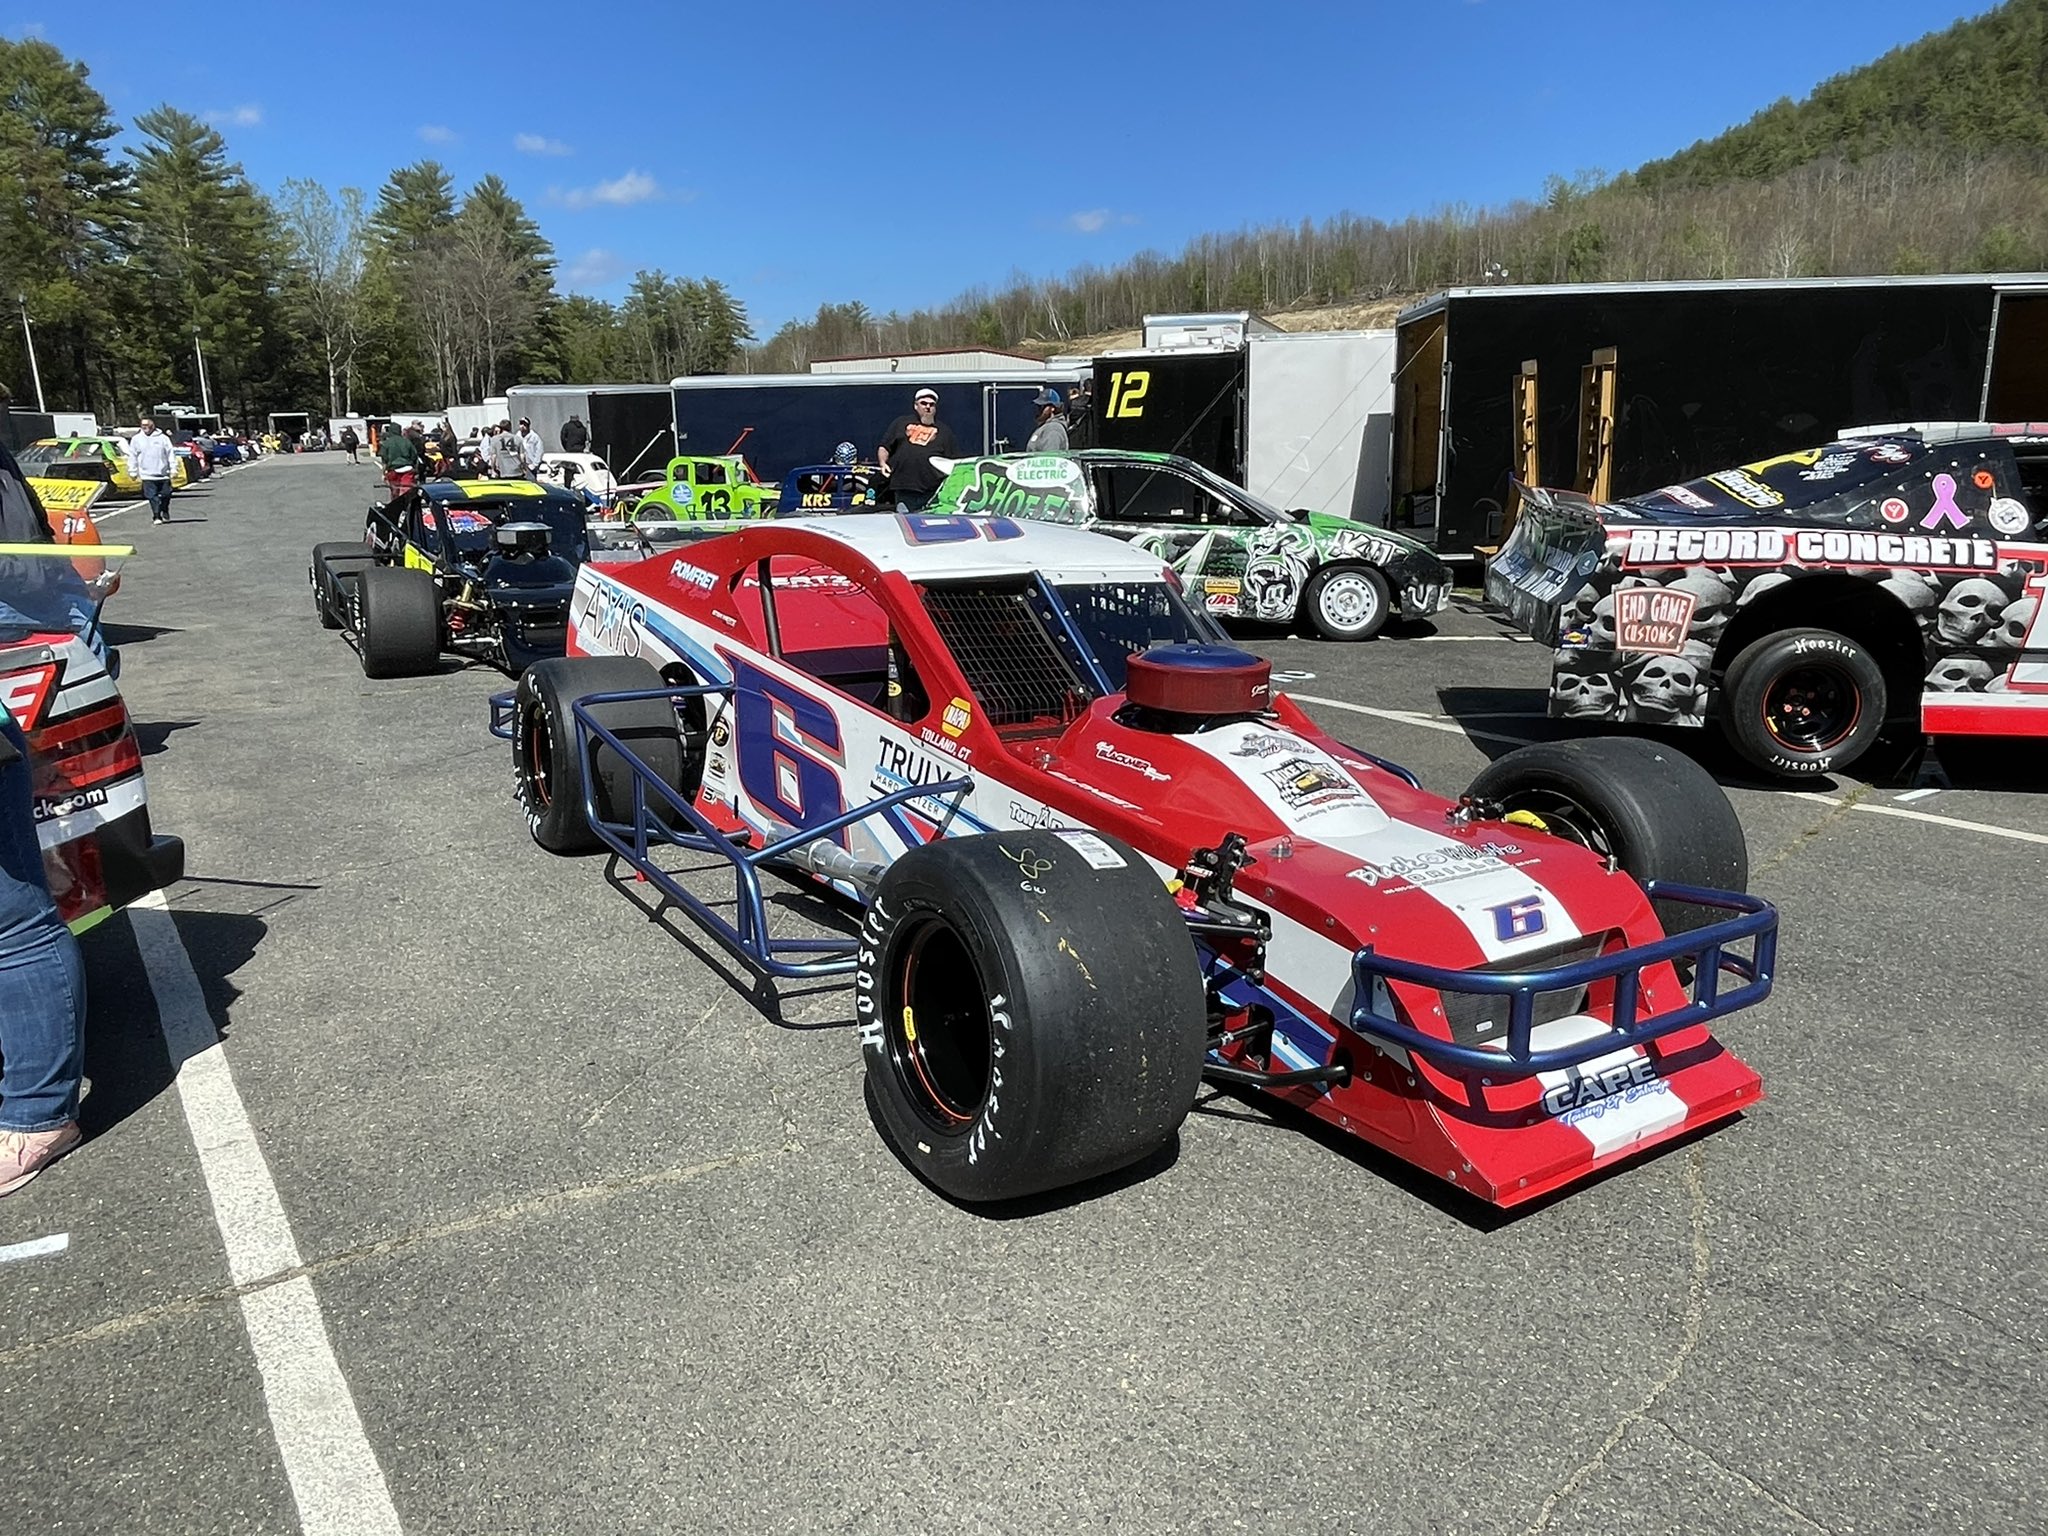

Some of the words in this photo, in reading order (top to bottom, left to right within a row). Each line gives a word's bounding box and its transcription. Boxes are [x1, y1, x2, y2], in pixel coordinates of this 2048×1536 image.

[1106, 371, 1150, 418] 12
[500, 437, 515, 450] 14
[1016, 469, 1069, 481] ELECTRIC
[701, 489, 731, 520] 13
[802, 494, 832, 507] KRS
[1626, 528, 1788, 563] RECORD
[1796, 531, 1996, 568] CONCRETE
[670, 558, 720, 591] POMFRET
[579, 580, 646, 658] AXIS
[1621, 593, 1647, 624] END
[1650, 592, 1688, 626] GAME
[1794, 638, 1857, 658] Hoosier
[714, 643, 846, 822] 6
[944, 704, 970, 731] NAPA
[878, 735, 952, 786] TRULY
[920, 726, 957, 757] TOLLAND,
[957, 746, 972, 761] CT
[1768, 754, 1832, 772] Hoosier
[876, 773, 900, 792] HARD
[1345, 856, 1429, 887] Black
[1482, 894, 1548, 944] 6
[856, 896, 893, 1054] Hoosier
[1544, 1056, 1656, 1115] CAPE
[1558, 1102, 1606, 1127] Towing
[1625, 1078, 1672, 1104] Salvage
